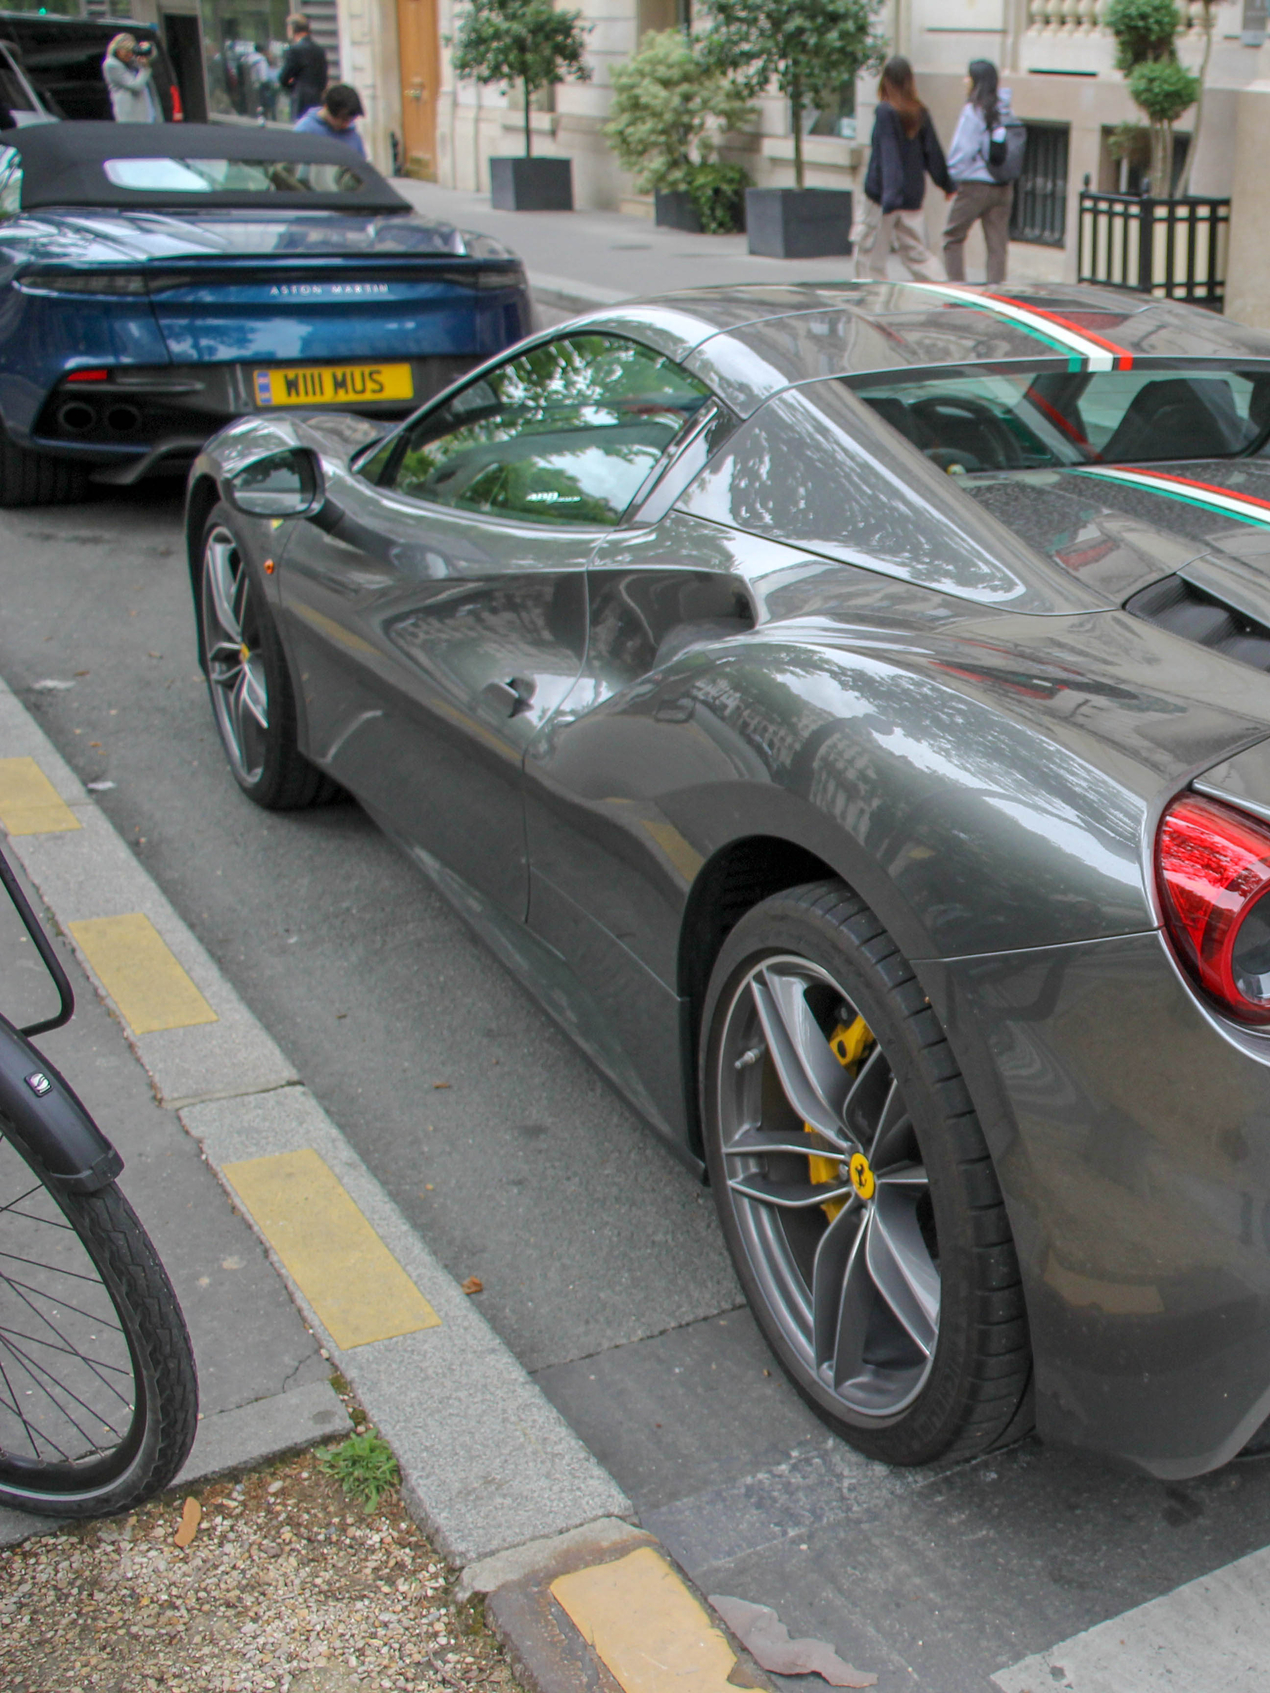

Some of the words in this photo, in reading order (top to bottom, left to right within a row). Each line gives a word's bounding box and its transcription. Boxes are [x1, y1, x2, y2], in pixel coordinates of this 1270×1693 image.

[270, 285, 322, 297] ASTON
[331, 283, 389, 295] MARTIN
[332, 369, 385, 396] MUS
